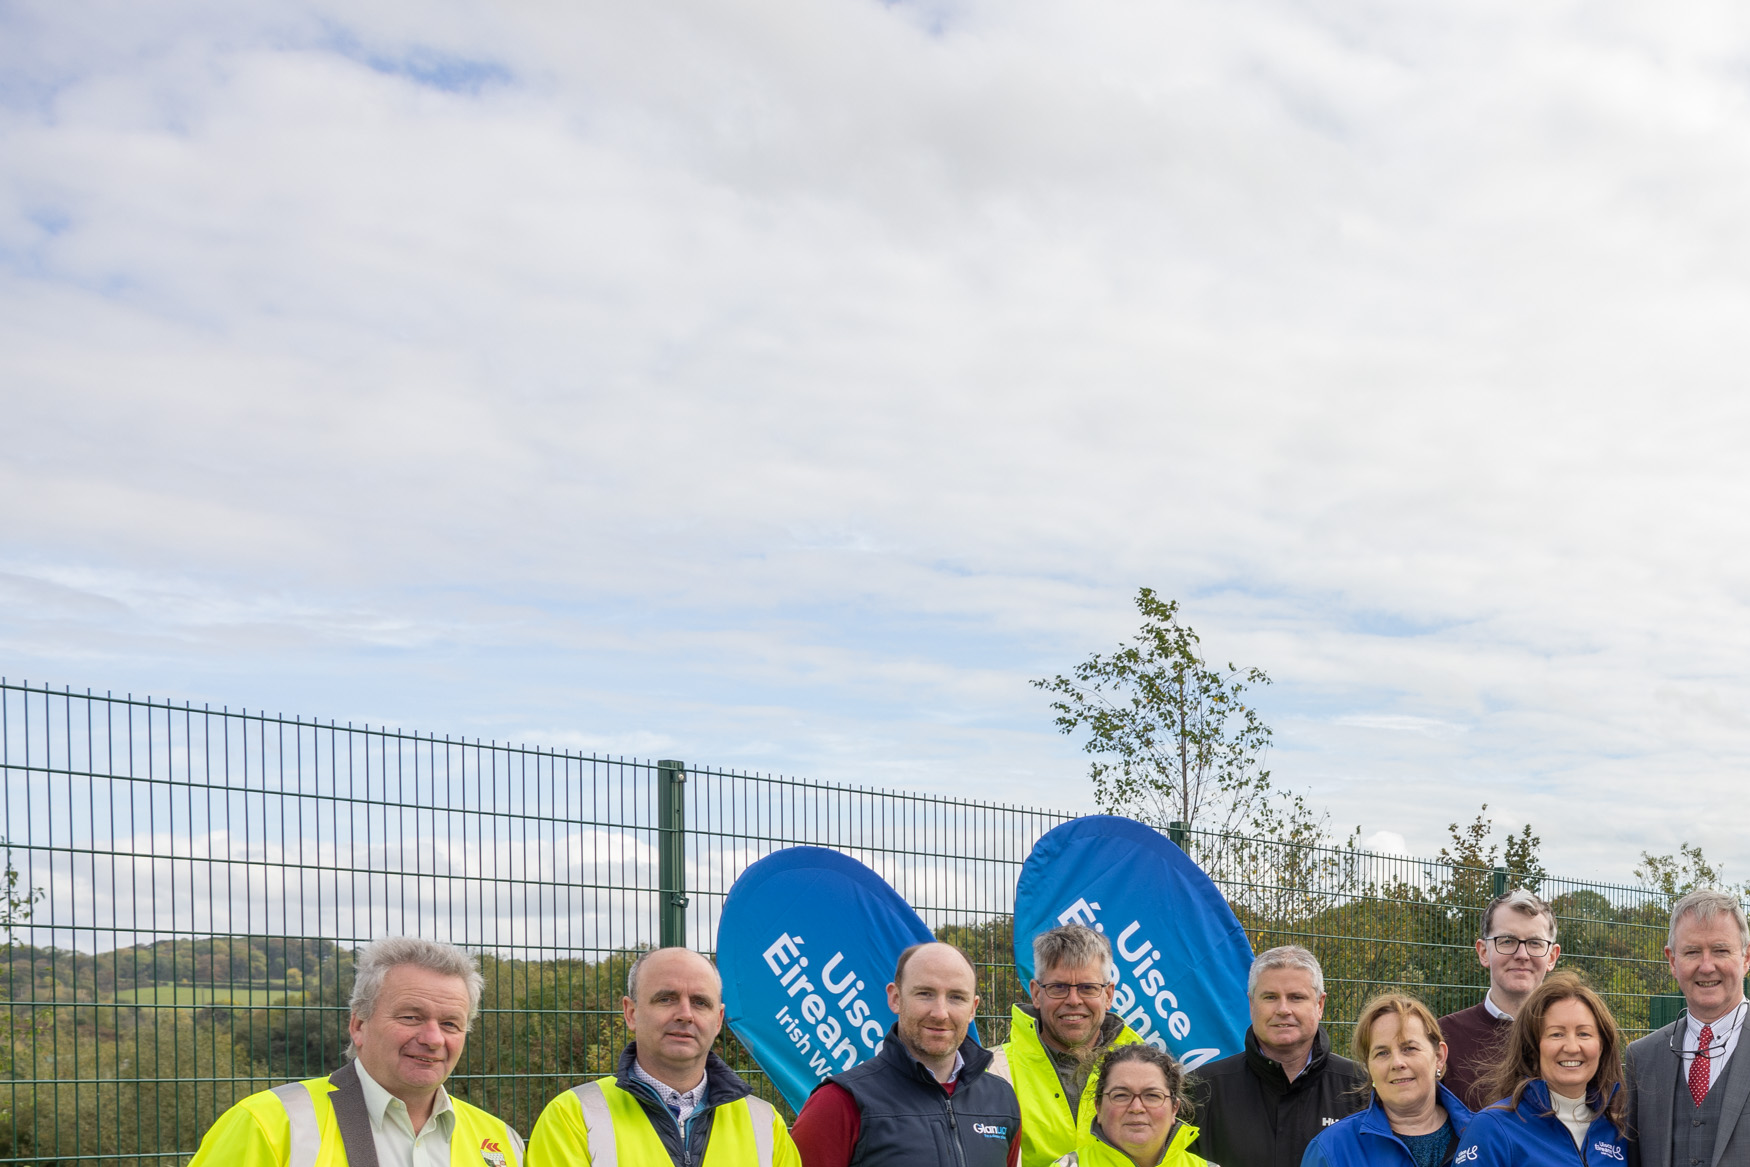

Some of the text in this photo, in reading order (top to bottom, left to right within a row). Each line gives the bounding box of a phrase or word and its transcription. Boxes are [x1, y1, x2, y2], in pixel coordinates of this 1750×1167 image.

[762, 932, 864, 1071] Éirean
[775, 1005, 811, 1055] Irish
[821, 951, 884, 1057] Uisc
[1117, 920, 1191, 1041] Uisce
[973, 1123, 1007, 1134] Glanua
